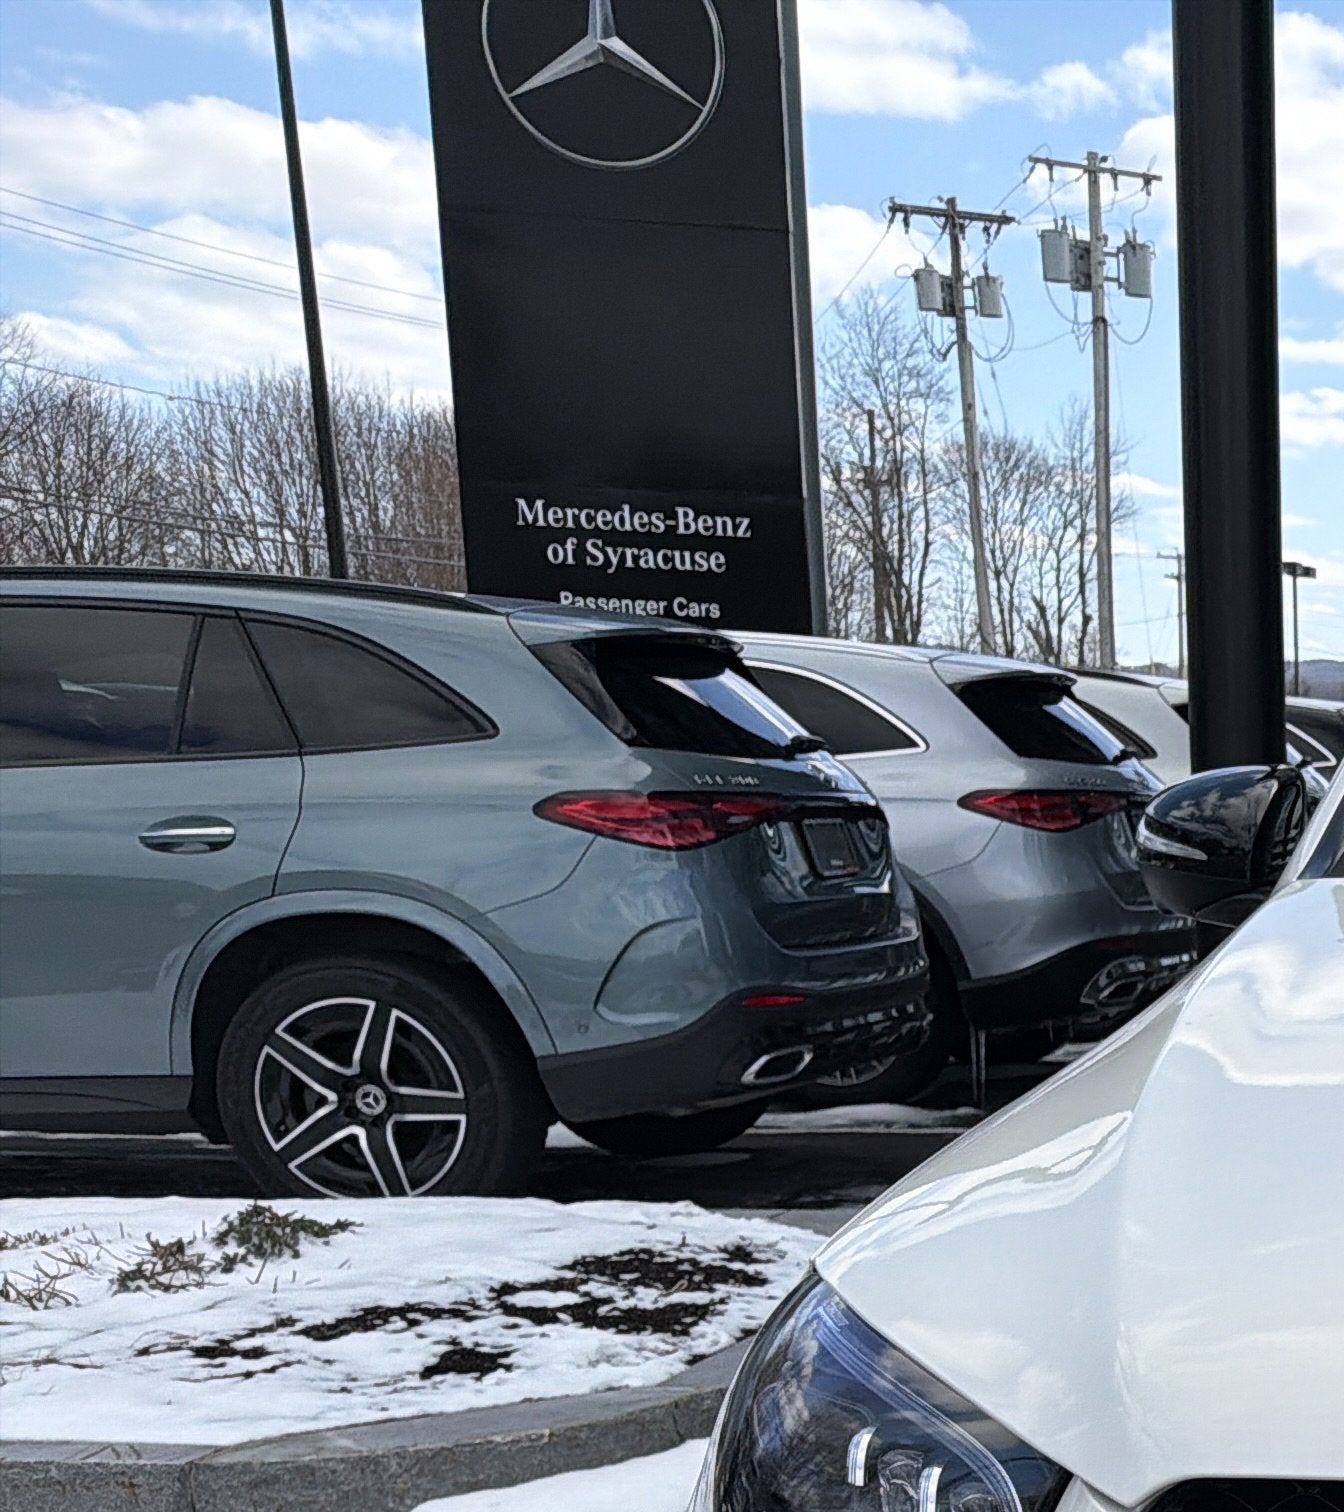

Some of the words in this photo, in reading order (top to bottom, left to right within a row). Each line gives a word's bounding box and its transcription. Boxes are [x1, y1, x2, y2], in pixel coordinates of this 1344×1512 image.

[515, 498, 752, 538] Mercedes-Benz
[546, 537, 576, 565] of
[585, 539, 727, 574] Syracuse
[672, 596, 721, 619] Cars
